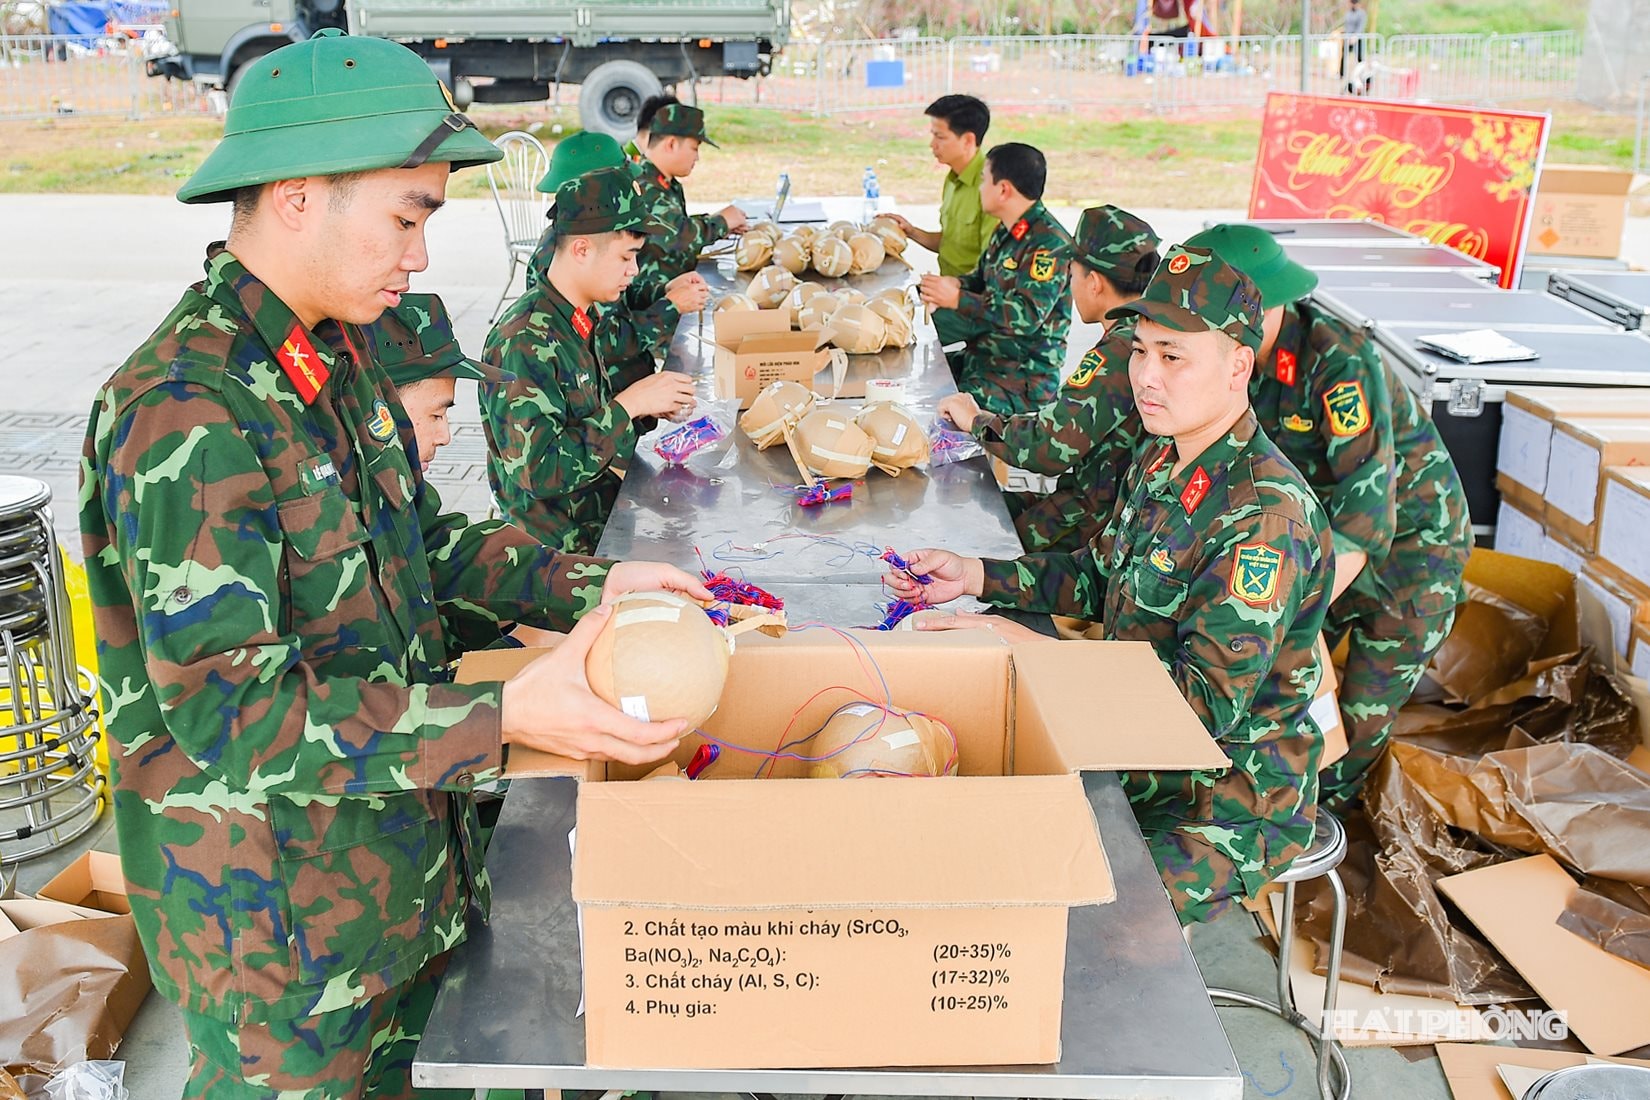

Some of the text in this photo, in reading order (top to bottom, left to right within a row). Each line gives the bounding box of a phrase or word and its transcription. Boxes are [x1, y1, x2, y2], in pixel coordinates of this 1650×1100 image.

[624, 920, 639, 936] 2.
[644, 917, 686, 937] Chất
[690, 922, 719, 940] tạo
[724, 920, 762, 937] màu
[767, 920, 794, 936] khi
[799, 919, 841, 939] cháy
[625, 973, 640, 989] 3.
[645, 970, 686, 989] Chất
[691, 973, 733, 993] cháy
[738, 973, 768, 992] (Al,
[773, 973, 790, 990] S,
[795, 972, 820, 991] C):
[625, 999, 640, 1014] 4.
[646, 999, 680, 1018] Phụ
[685, 1000, 717, 1018] gia:
